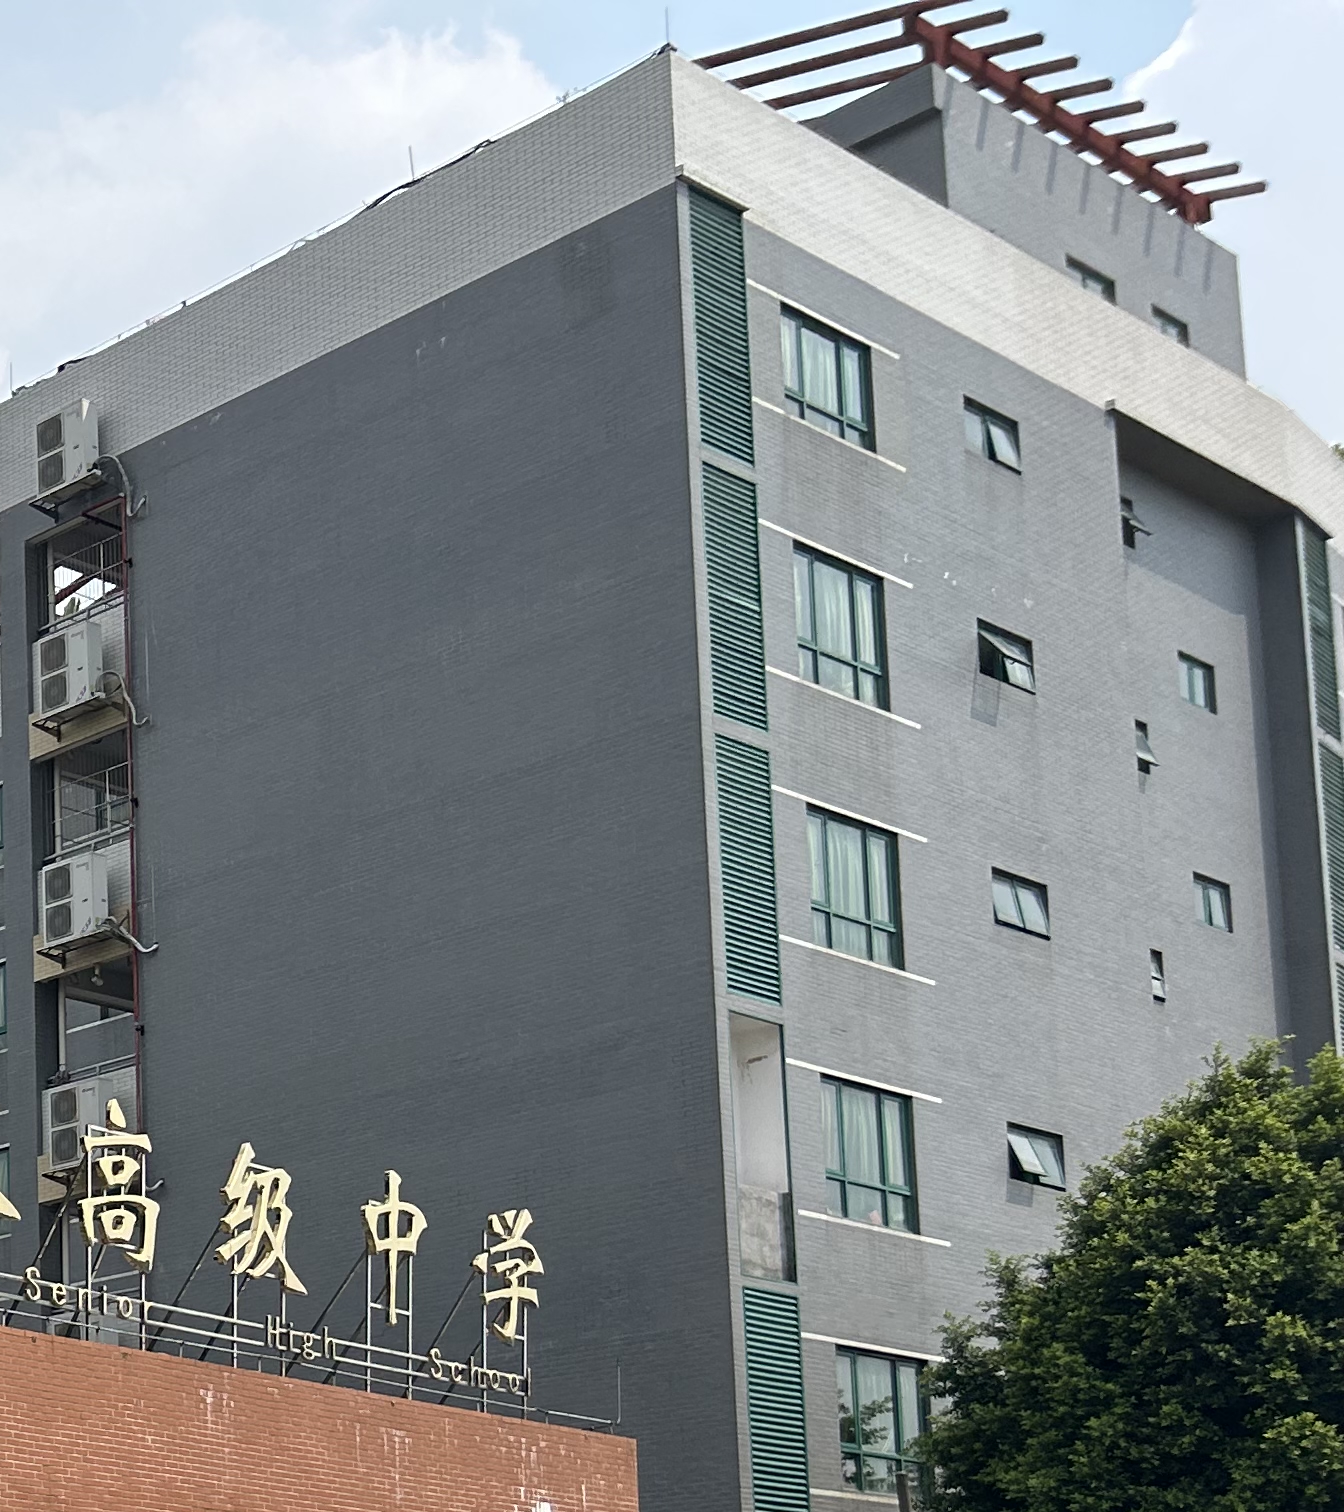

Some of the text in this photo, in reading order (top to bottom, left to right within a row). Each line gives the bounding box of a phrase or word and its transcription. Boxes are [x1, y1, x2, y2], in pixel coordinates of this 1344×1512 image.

[23, 1265, 154, 1325] Senior
[265, 1314, 336, 1360] High
[427, 1347, 532, 1397] School
